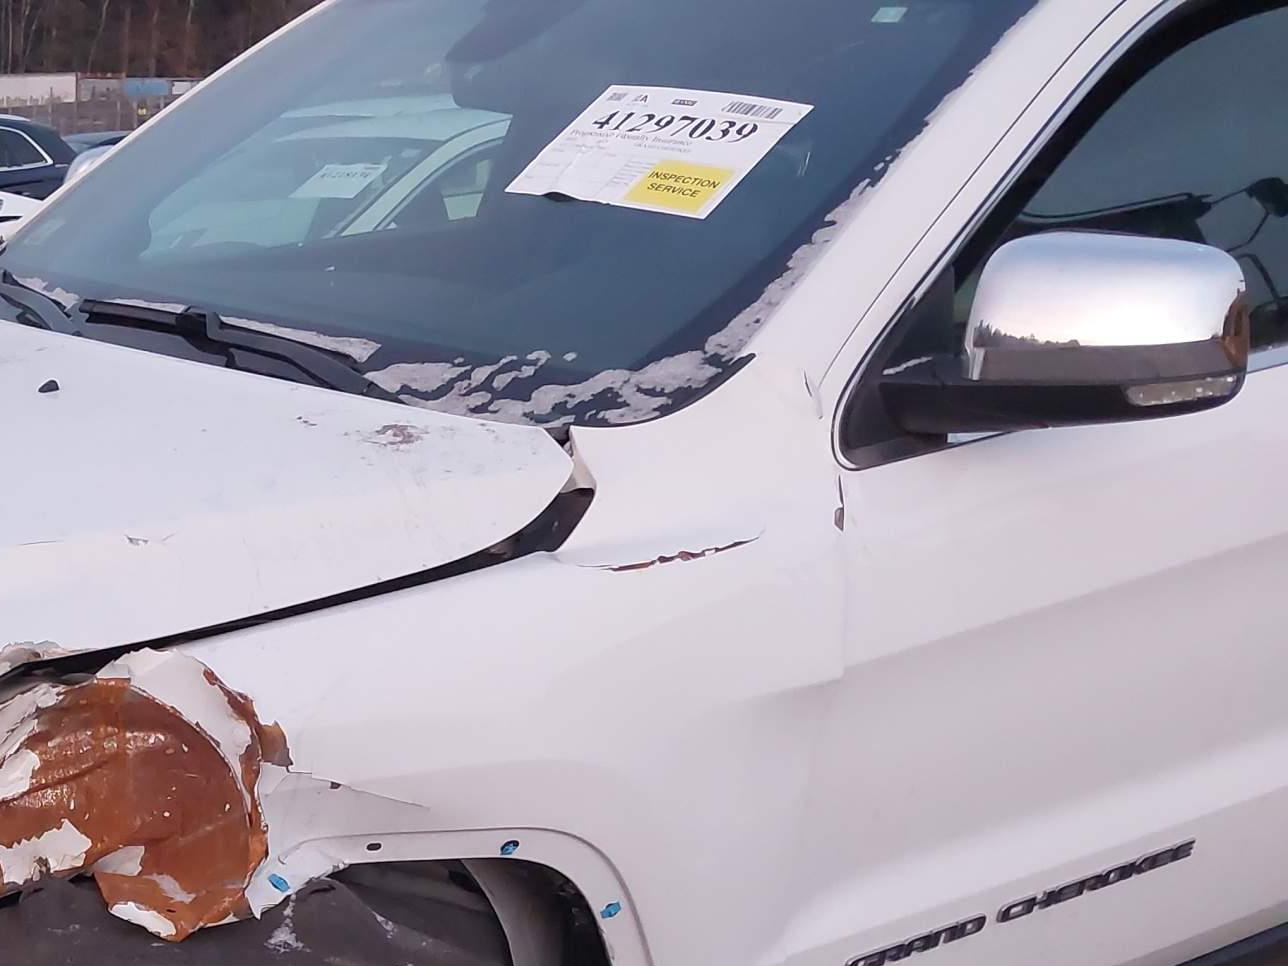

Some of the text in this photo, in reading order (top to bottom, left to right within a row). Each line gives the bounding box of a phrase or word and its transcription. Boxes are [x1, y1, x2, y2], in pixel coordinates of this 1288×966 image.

[592, 110, 759, 143] 41297039
[647, 182, 701, 198] SERVICE
[648, 170, 721, 189] INSPECTION
[996, 837, 1197, 923] CHEROKEE
